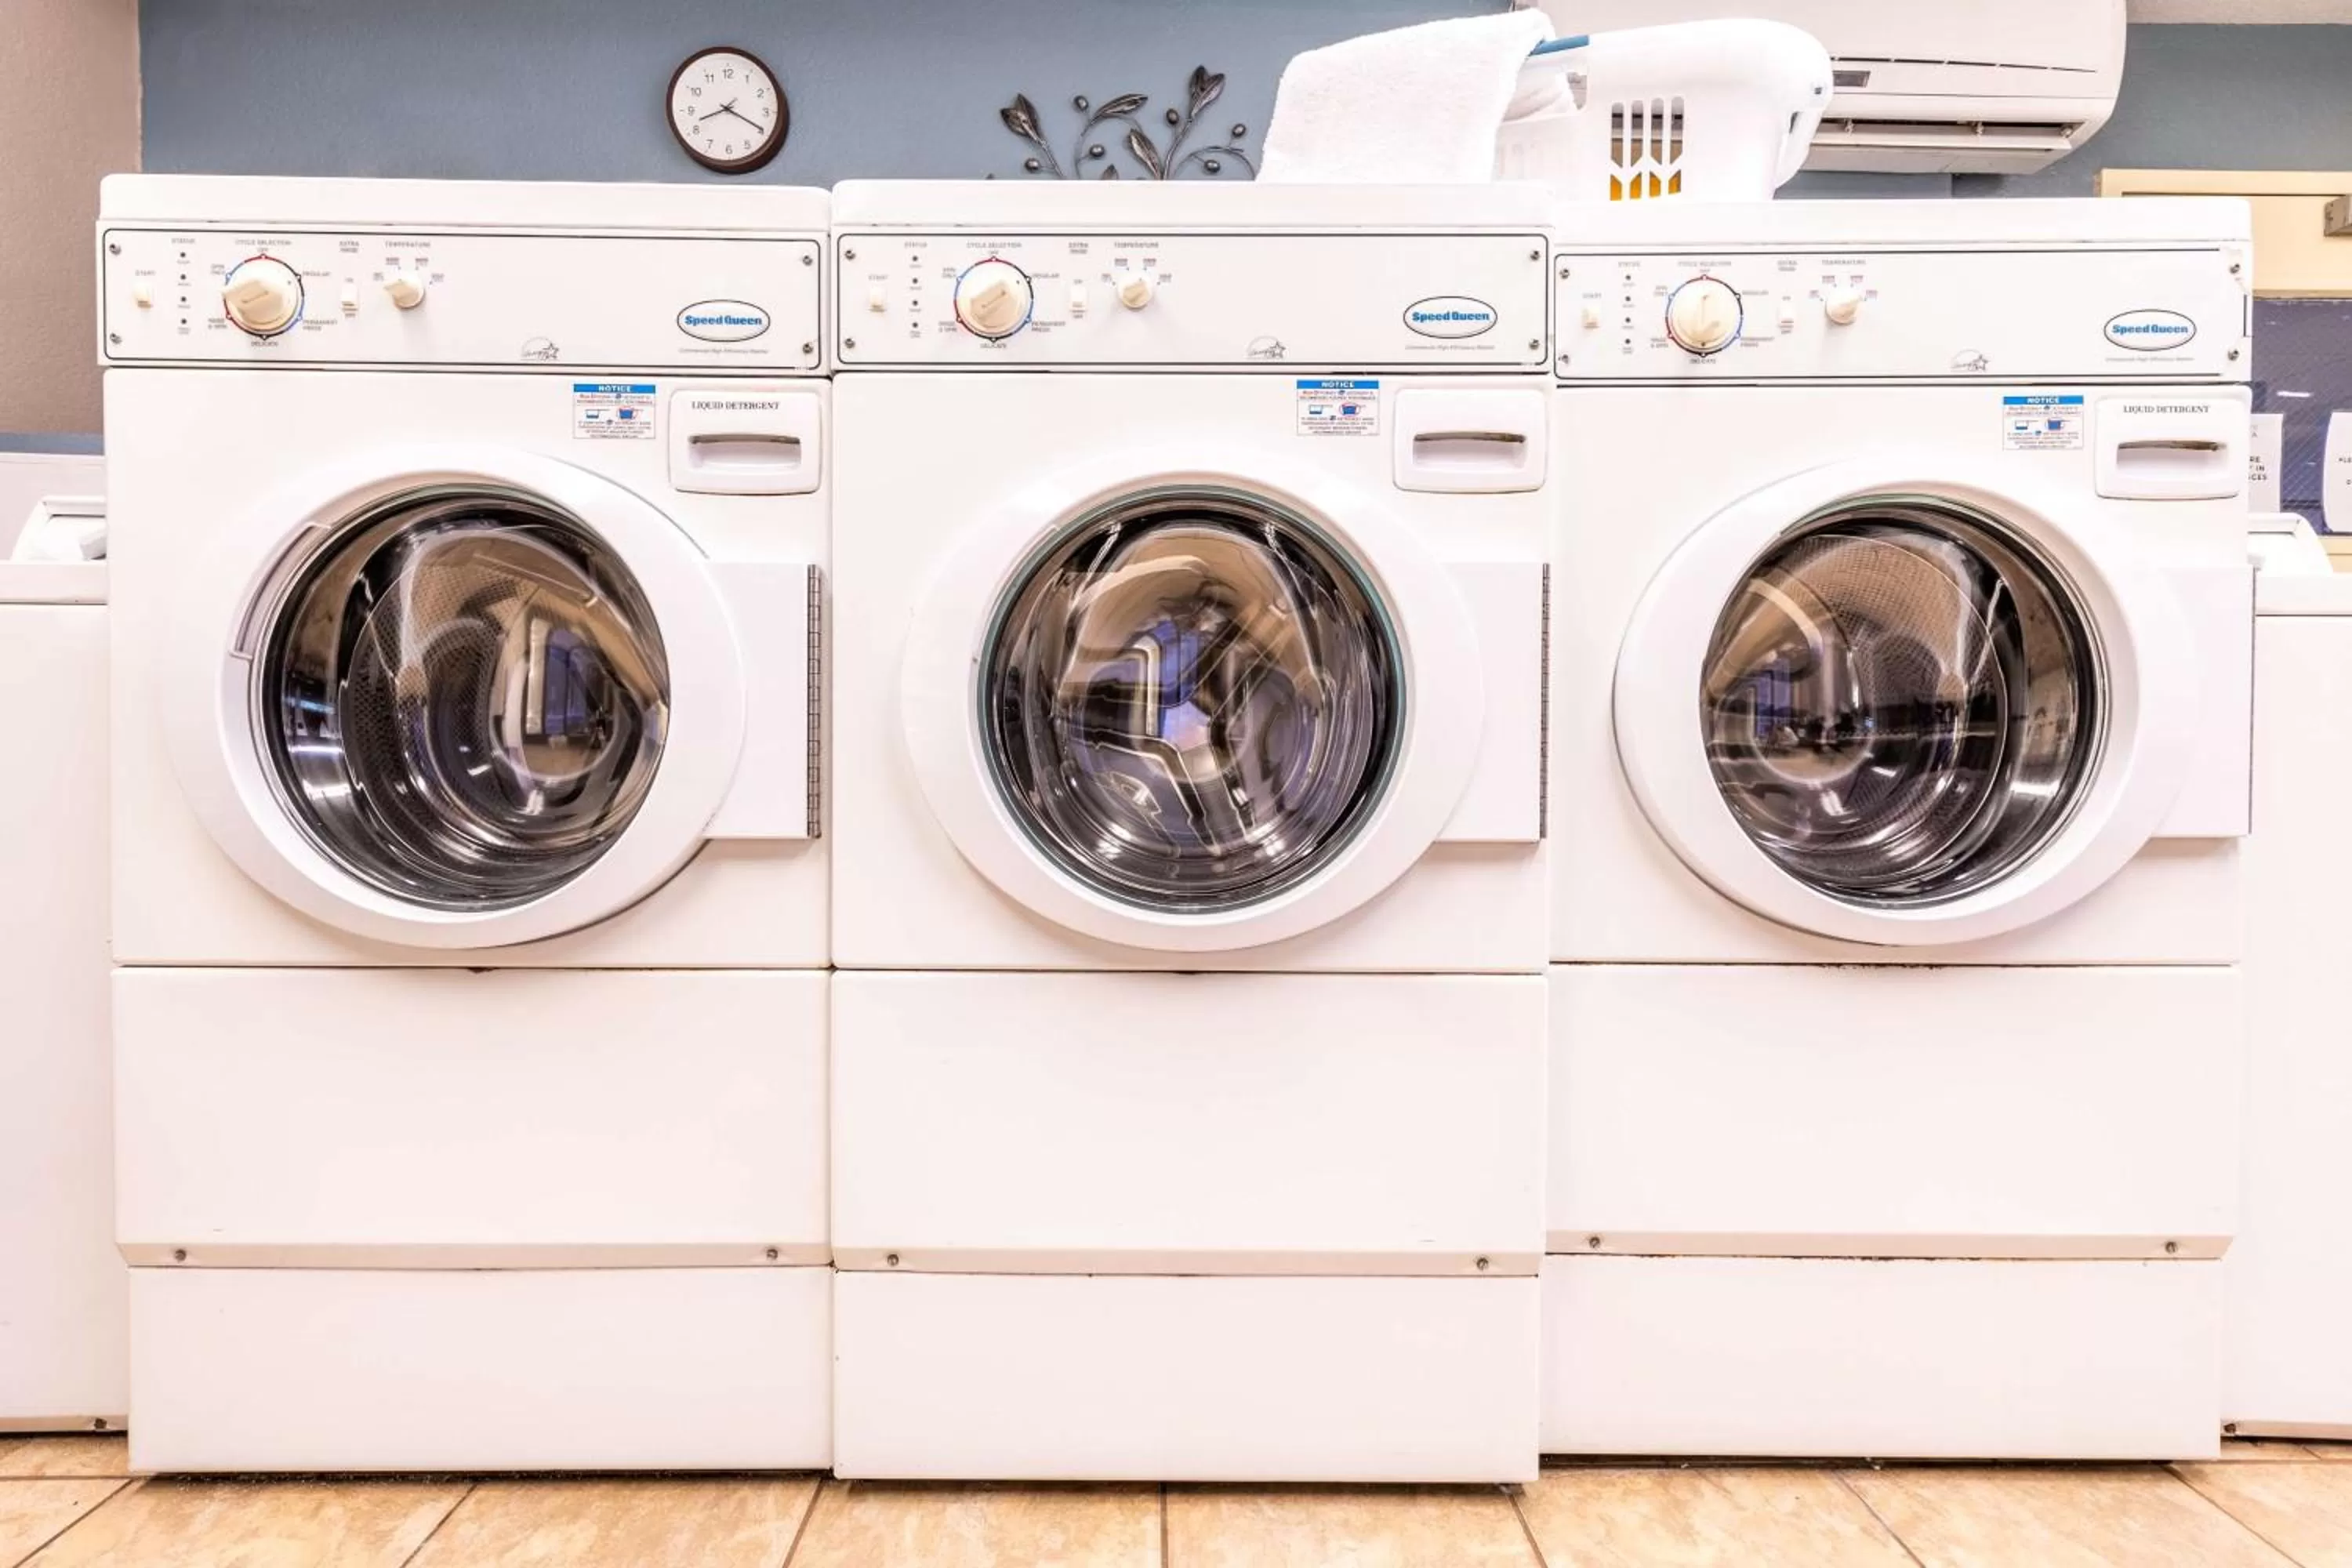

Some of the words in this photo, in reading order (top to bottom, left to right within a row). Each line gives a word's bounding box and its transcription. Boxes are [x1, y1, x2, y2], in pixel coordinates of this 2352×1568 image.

[705, 73, 714, 83] 11
[722, 68, 735, 79] 12
[691, 86, 702, 97] 10
[757, 89, 764, 99] 2
[688, 106, 695, 116] 9
[762, 107, 769, 117] 3
[693, 125, 700, 136] 8
[706, 139, 713, 150] 7
[725, 144, 733, 154] 6
[745, 140, 752, 150] 5
[684, 314, 723, 326] Speed
[724, 315, 762, 325] Queen
[1412, 311, 1450, 323] Speed
[1451, 311, 1490, 321] Queen
[2112, 324, 2150, 335] Speed
[2151, 324, 2188, 333] Queen
[598, 384, 632, 393] NOTICE
[691, 401, 724, 411] LIQUID
[725, 401, 780, 410] DETERGENT
[2123, 405, 2154, 414] LIQUID
[2156, 405, 2211, 413] DETERGENT
